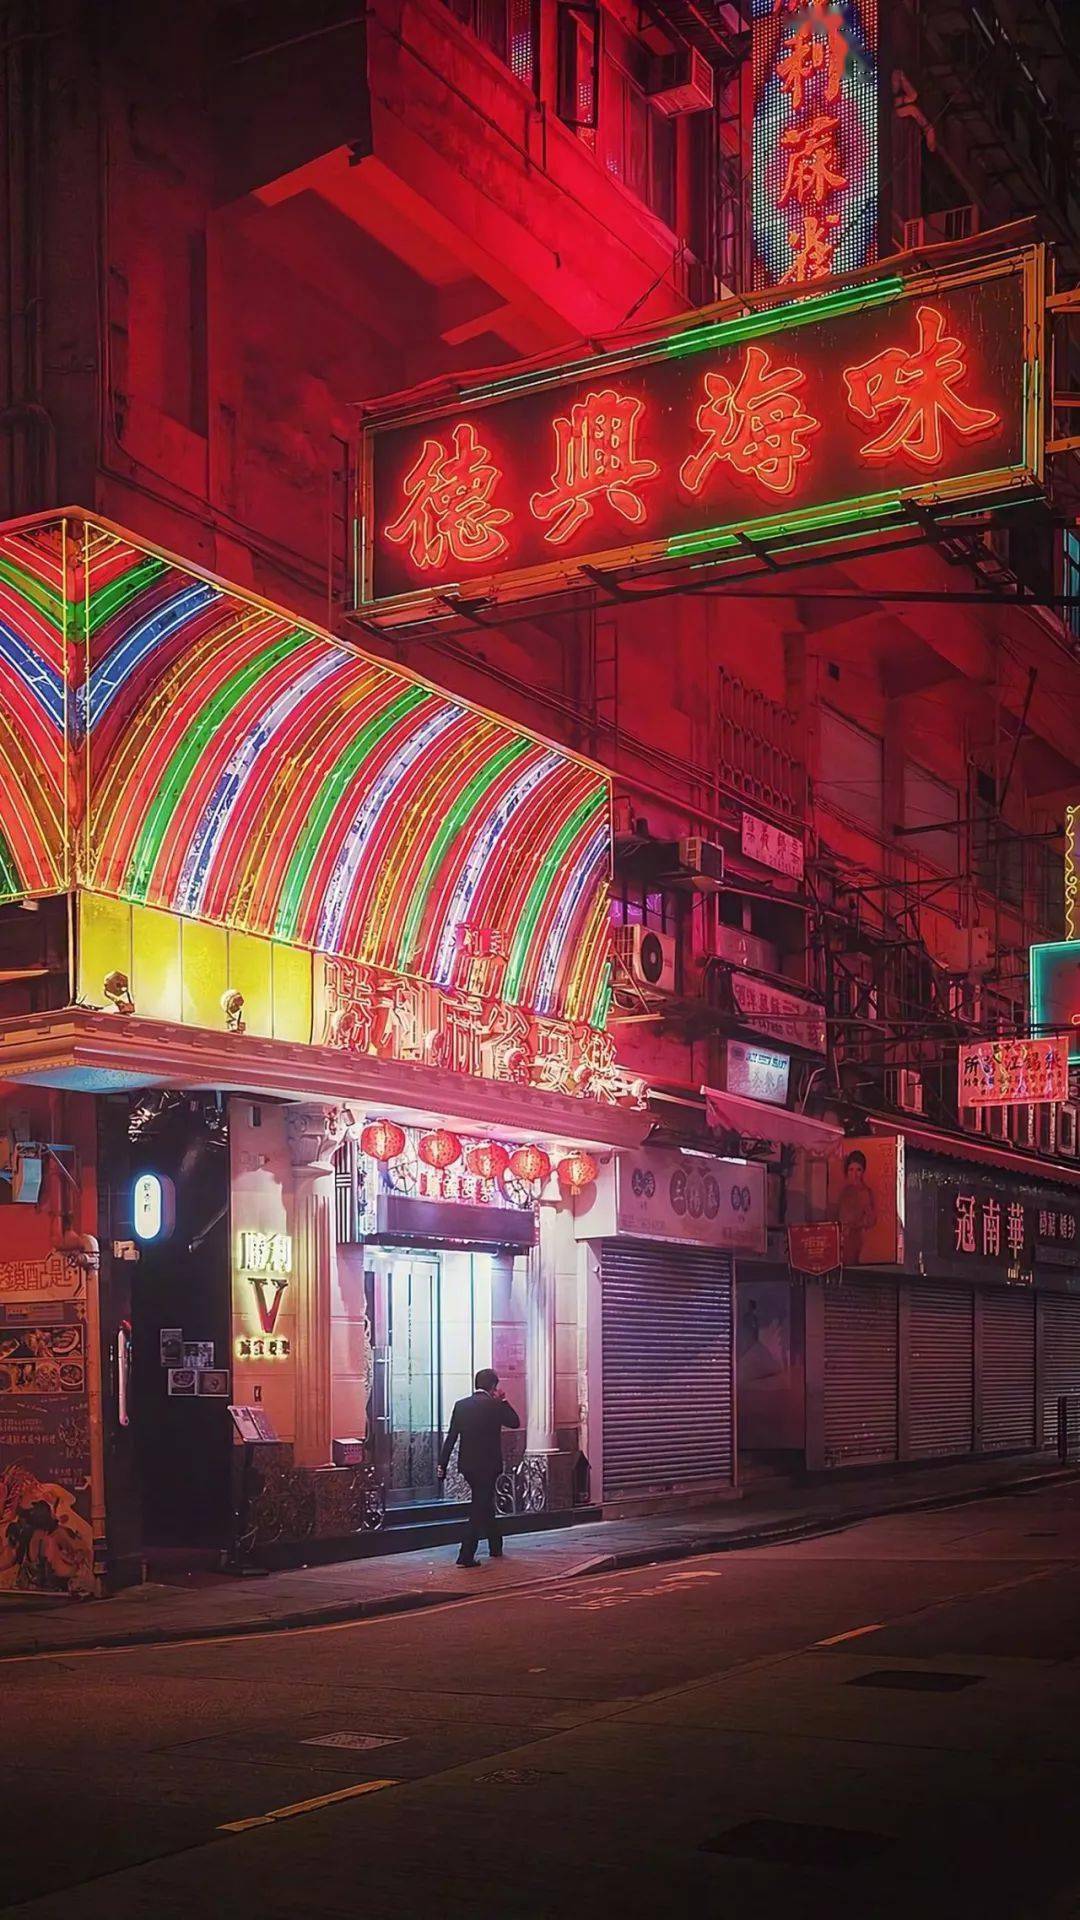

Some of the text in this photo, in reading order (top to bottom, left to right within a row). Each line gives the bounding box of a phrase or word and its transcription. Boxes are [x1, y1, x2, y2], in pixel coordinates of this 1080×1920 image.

[770, 0, 849, 284] 利麻雀
[385, 306, 999, 569] 德興海味
[247, 1277, 289, 1334] V
[955, 1192, 1025, 1259] 冠南華
